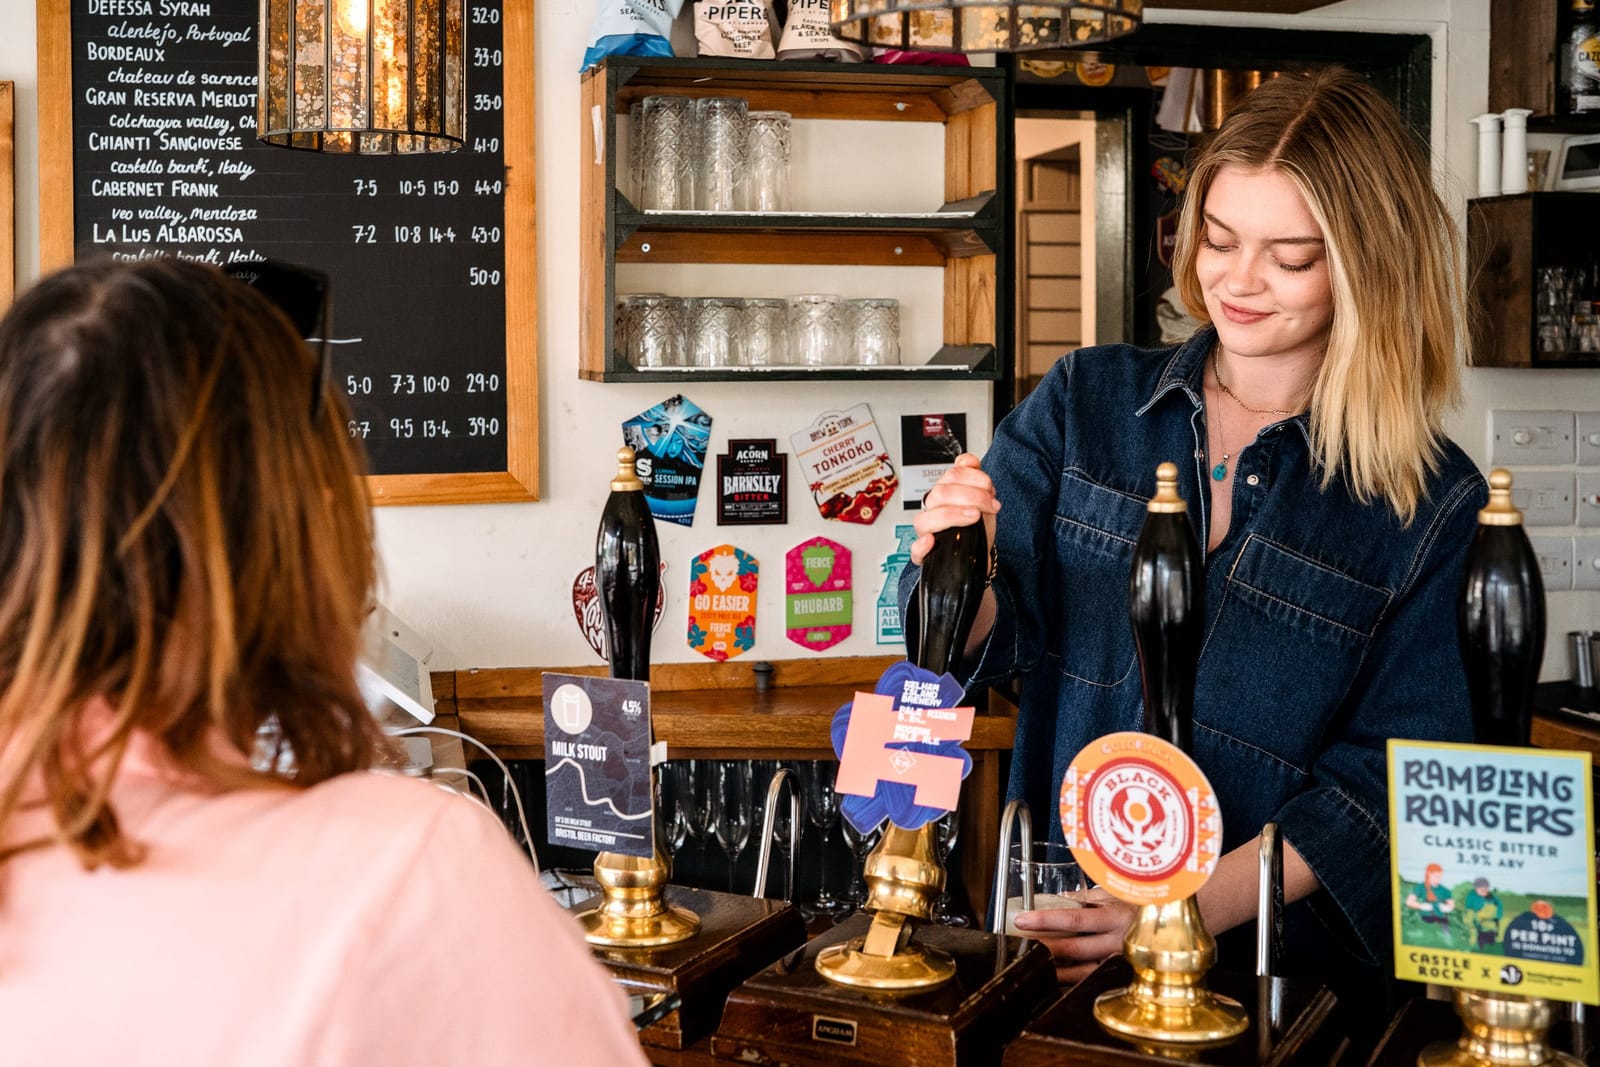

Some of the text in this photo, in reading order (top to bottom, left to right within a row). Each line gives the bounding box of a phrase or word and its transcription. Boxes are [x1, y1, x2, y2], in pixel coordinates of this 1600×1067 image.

[88, 0, 211, 16] DEFESSA SYRAH
[186, 24, 251, 47] Portugal
[87, 42, 165, 62] BORDEAUX
[177, 70, 196, 85] de
[86, 88, 258, 108] GRAN RESERVA MERLOT
[186, 115, 235, 136] valley,
[89, 132, 243, 151] CHIANTI SANGIOVESE
[110, 158, 164, 174] castello
[217, 159, 256, 181] Italy
[92, 179, 219, 197] CABERNET FRANK
[138, 205, 187, 226] valley,
[190, 205, 258, 220] Mendoza
[93, 223, 244, 244] LA LUS ALBAROSSA
[736, 450, 769, 460] ACORN
[822, 435, 856, 457] CHERRY
[812, 440, 874, 475] TONKOKO
[654, 474, 697, 486] SESSION IPA
[723, 475, 781, 496] BARNSLEY
[734, 493, 769, 501] BITTER
[694, 594, 750, 612] GO EASIER
[794, 597, 844, 615] RHUBARB
[881, 608, 899, 617] AIN
[881, 618, 900, 627] ALE
[622, 700, 642, 714] 4.5%
[552, 740, 608, 762] MILK STOUT
[1105, 772, 1173, 801] BLACK
[1404, 759, 1574, 801] RAMBLING
[1405, 794, 1575, 837] RANGERS
[592, 832, 616, 846] FACTORY
[1424, 834, 1558, 858] CLASSIC BITTER
[1113, 847, 1163, 868] ISLE
[1456, 852, 1525, 869] 3.9% ABV
[1510, 929, 1577, 948] PER PINT
[1410, 952, 1471, 970] CASTLE
[1418, 966, 1464, 981] ROCK
